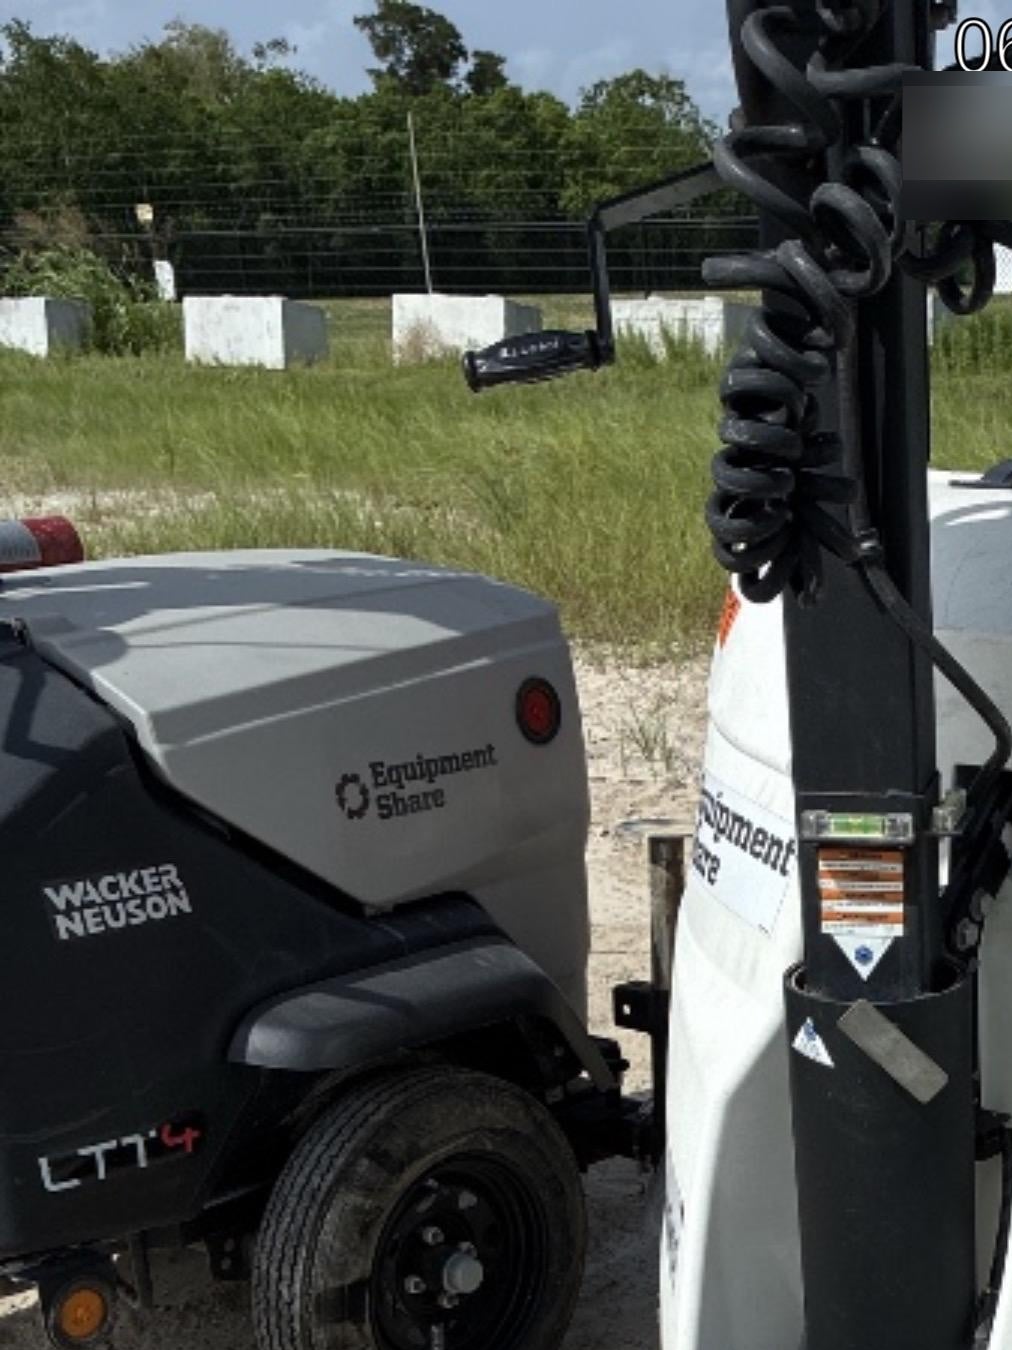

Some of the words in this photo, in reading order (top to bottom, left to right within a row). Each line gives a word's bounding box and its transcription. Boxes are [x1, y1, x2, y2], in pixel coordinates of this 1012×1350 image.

[368, 743, 498, 790] Equipment
[375, 788, 445, 820] Share
[43, 863, 184, 911] WACKER
[54, 887, 193, 940] NEUSON
